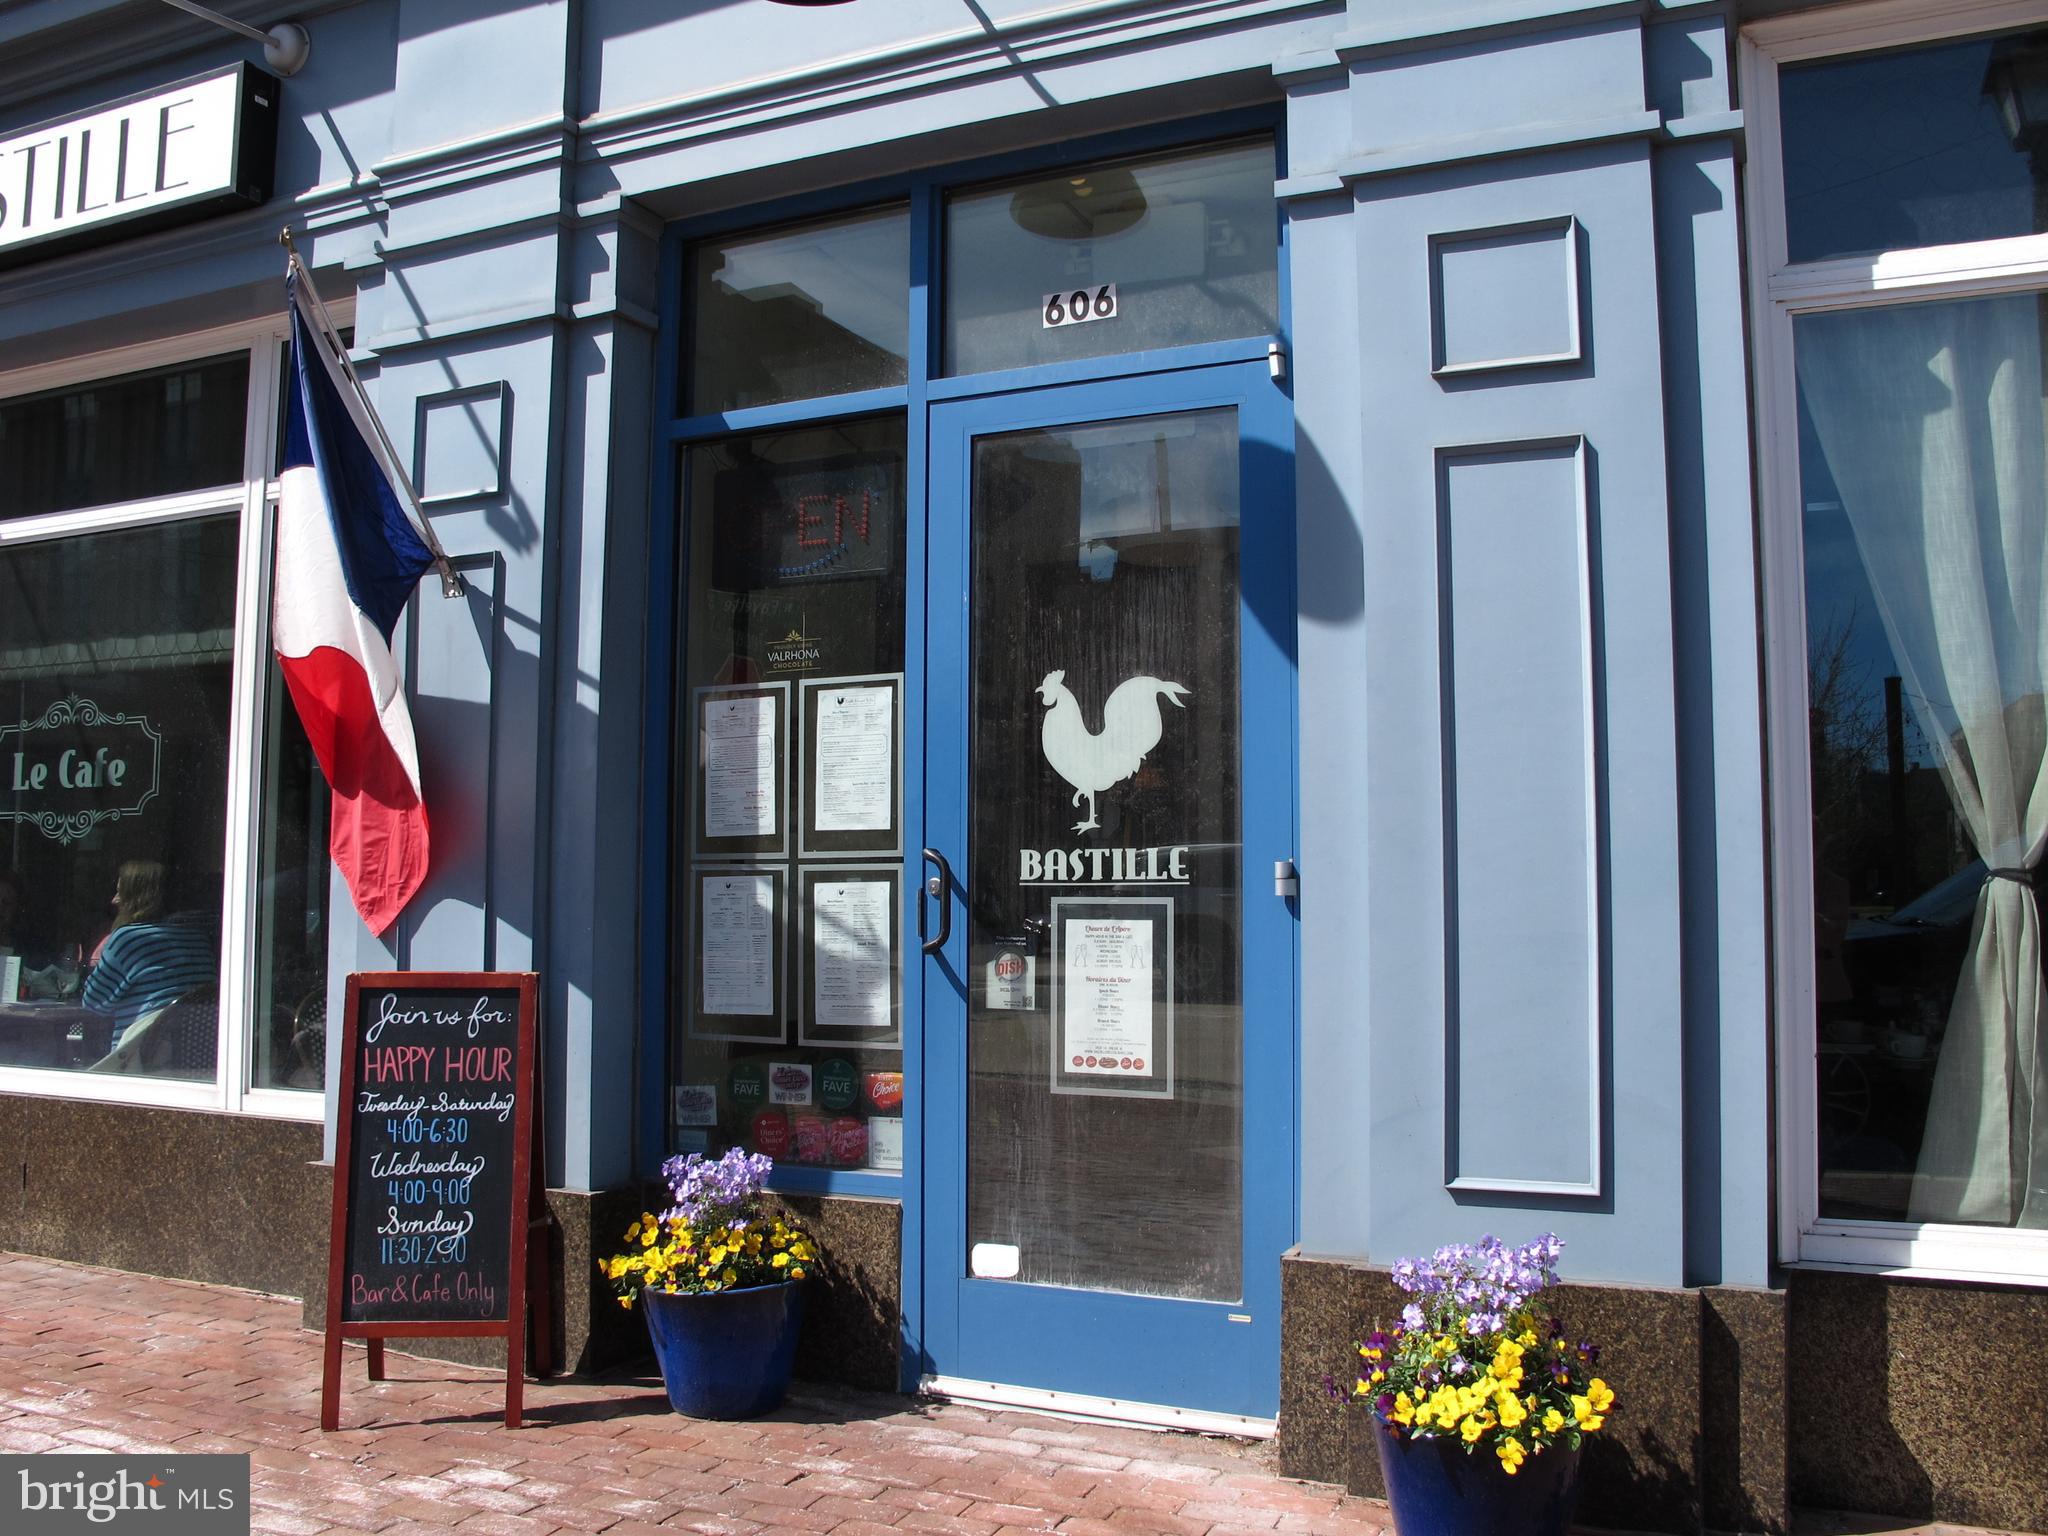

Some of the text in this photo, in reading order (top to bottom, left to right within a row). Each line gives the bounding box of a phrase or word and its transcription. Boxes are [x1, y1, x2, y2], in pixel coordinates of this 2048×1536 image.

[1045, 285, 1114, 325] 606
[767, 649, 820, 662] VALRHONA
[773, 661, 813, 669] CHOCOLATE
[12, 747, 126, 790] Le Cafe
[1019, 847, 1190, 881] BASTILLE
[996, 960, 1025, 976] DISH
[366, 993, 512, 1043] Join us for:
[364, 1046, 512, 1083] HAPPY HOUR
[734, 1084, 760, 1096] FAVE
[823, 1080, 851, 1093] FAVE
[872, 1082, 900, 1098] Choice
[387, 1118, 468, 1143] 4:00-6:30
[371, 1151, 485, 1188] Wednesday
[388, 1178, 470, 1205] 4:00-9:00
[377, 1206, 474, 1254] Sunday
[412, 1273, 451, 1303] Cafe
[457, 1272, 494, 1317] Only
